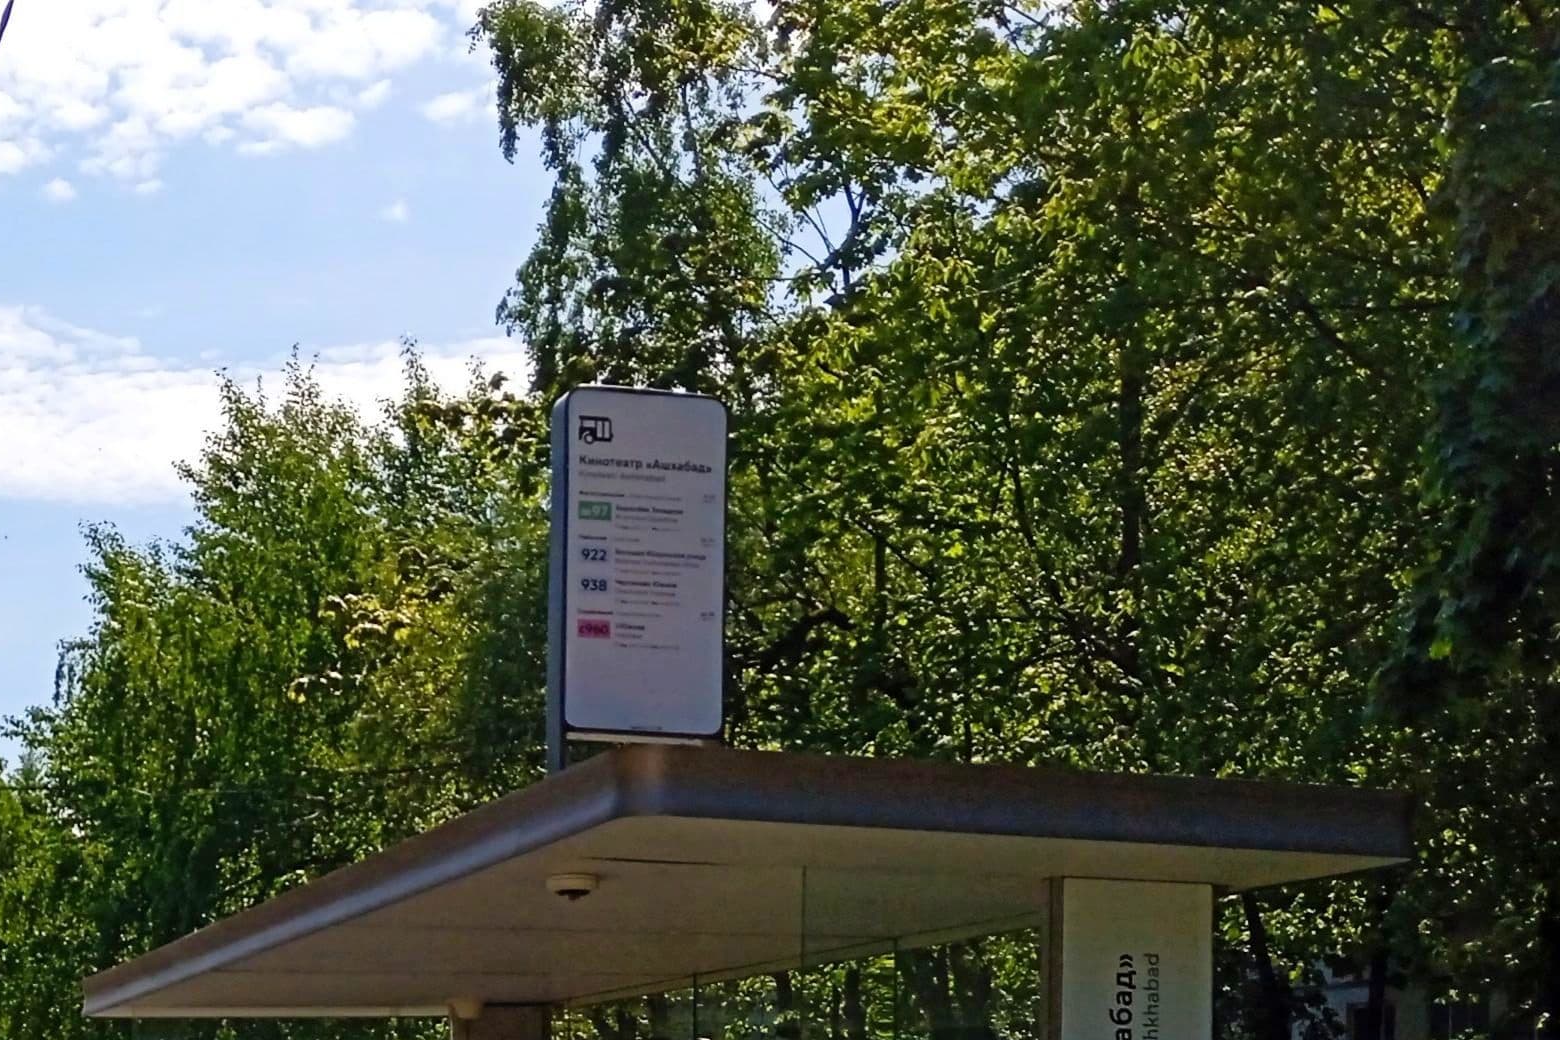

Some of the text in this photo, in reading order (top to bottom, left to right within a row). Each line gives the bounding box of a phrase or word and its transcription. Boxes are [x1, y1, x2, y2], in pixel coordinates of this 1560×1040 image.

[578, 455, 712, 474] Кинотеатр «Ашхабад»
[581, 548, 608, 562] 922
[580, 578, 608, 592] 938
